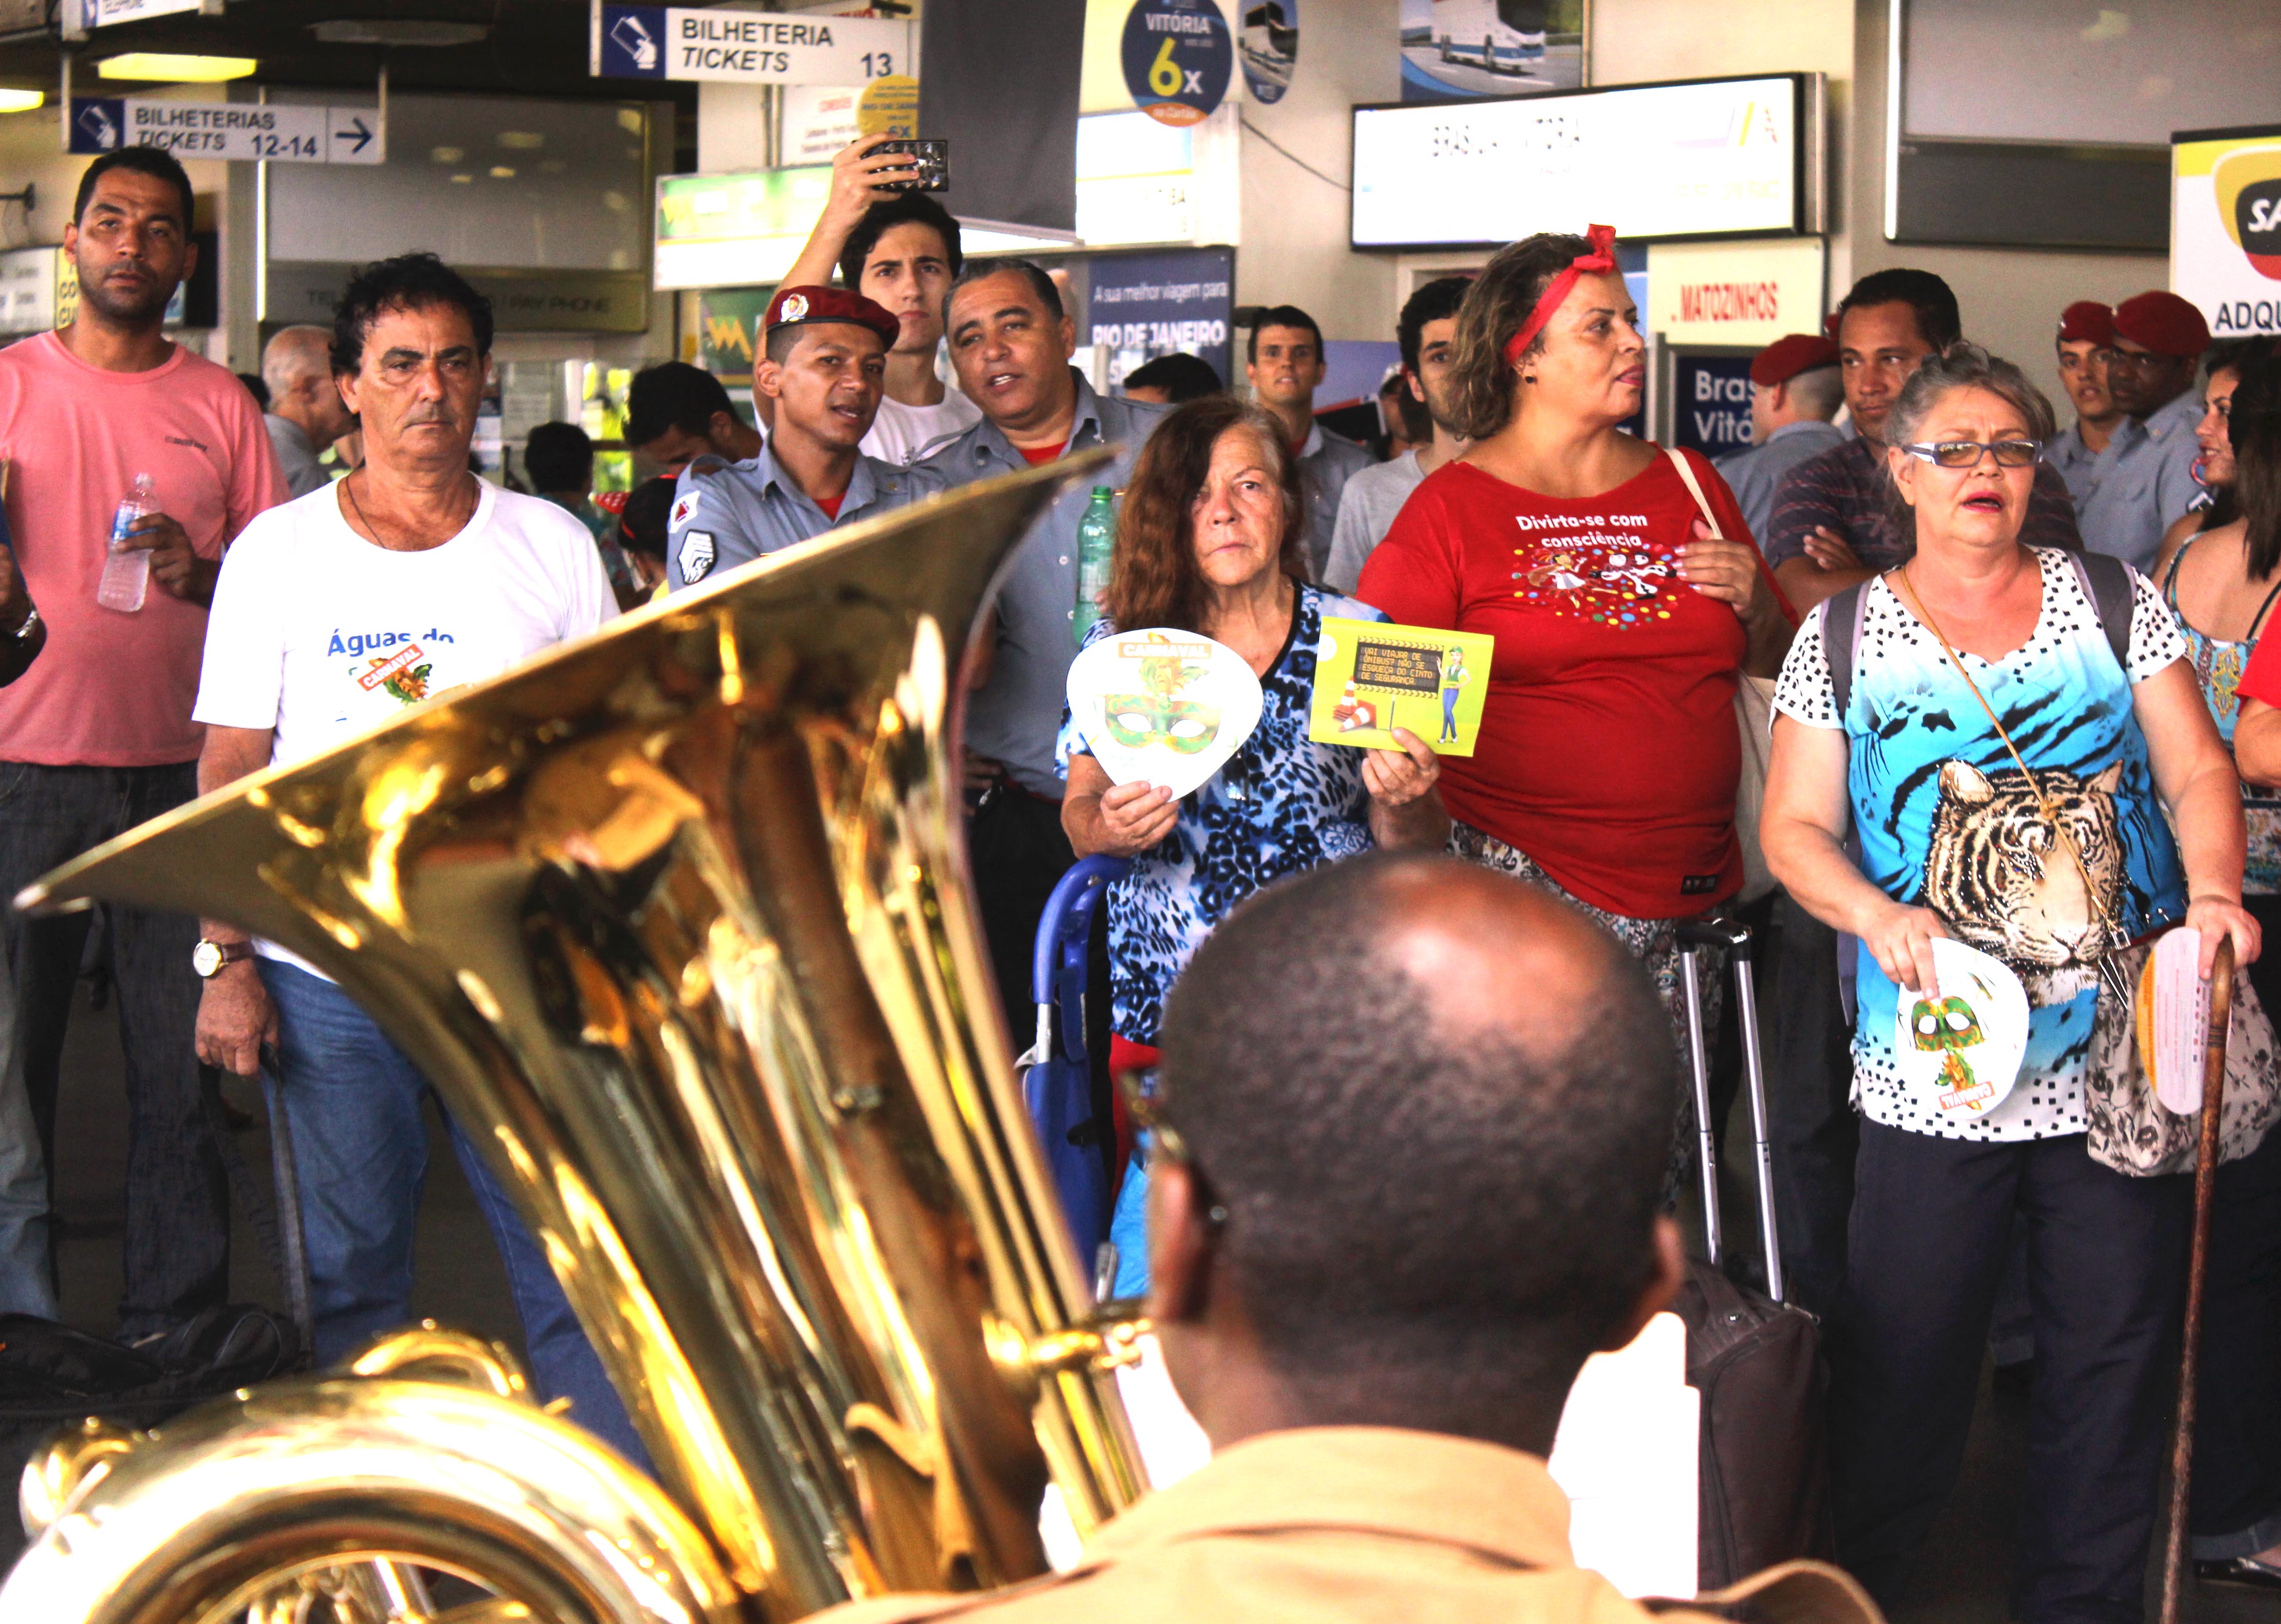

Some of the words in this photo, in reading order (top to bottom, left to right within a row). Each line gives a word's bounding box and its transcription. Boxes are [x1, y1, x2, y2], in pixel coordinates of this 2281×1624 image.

[682, 17, 833, 47] BILHETERIA
[1146, 10, 1212, 34] VITÓRIA
[682, 46, 789, 72] TICKETS
[860, 52, 893, 78] 13
[135, 106, 275, 131] BILHETERIAS
[136, 130, 225, 151] TICKETS
[251, 134, 317, 157] 12-14
[1124, 282, 1159, 301] melhor
[1162, 282, 1200, 303] viagem
[1203, 282, 1228, 300] para
[1681, 282, 1777, 322] MATOZINHOS
[1092, 323, 1123, 350] RIO
[1124, 322, 1148, 348] DE
[1149, 320, 1226, 347] JANEIRO
[1515, 514, 1605, 531] Divirta-se
[1609, 514, 1648, 527] com
[1541, 530, 1642, 548] consciência
[1123, 643, 1209, 658] CARNAVAL
[1364, 647, 1378, 655] VAI
[1381, 648, 1408, 659] VIAJAR
[1412, 653, 1422, 661] DE
[361, 647, 421, 689] CARNAVAL
[1361, 672, 1371, 680] DE
[1397, 667, 1407, 676] DO
[1410, 669, 1432, 679] CINTO
[1398, 659, 1412, 669] NÃO
[1415, 662, 1425, 670] SE
[1941, 1083, 1992, 1109] CARNAVAL
